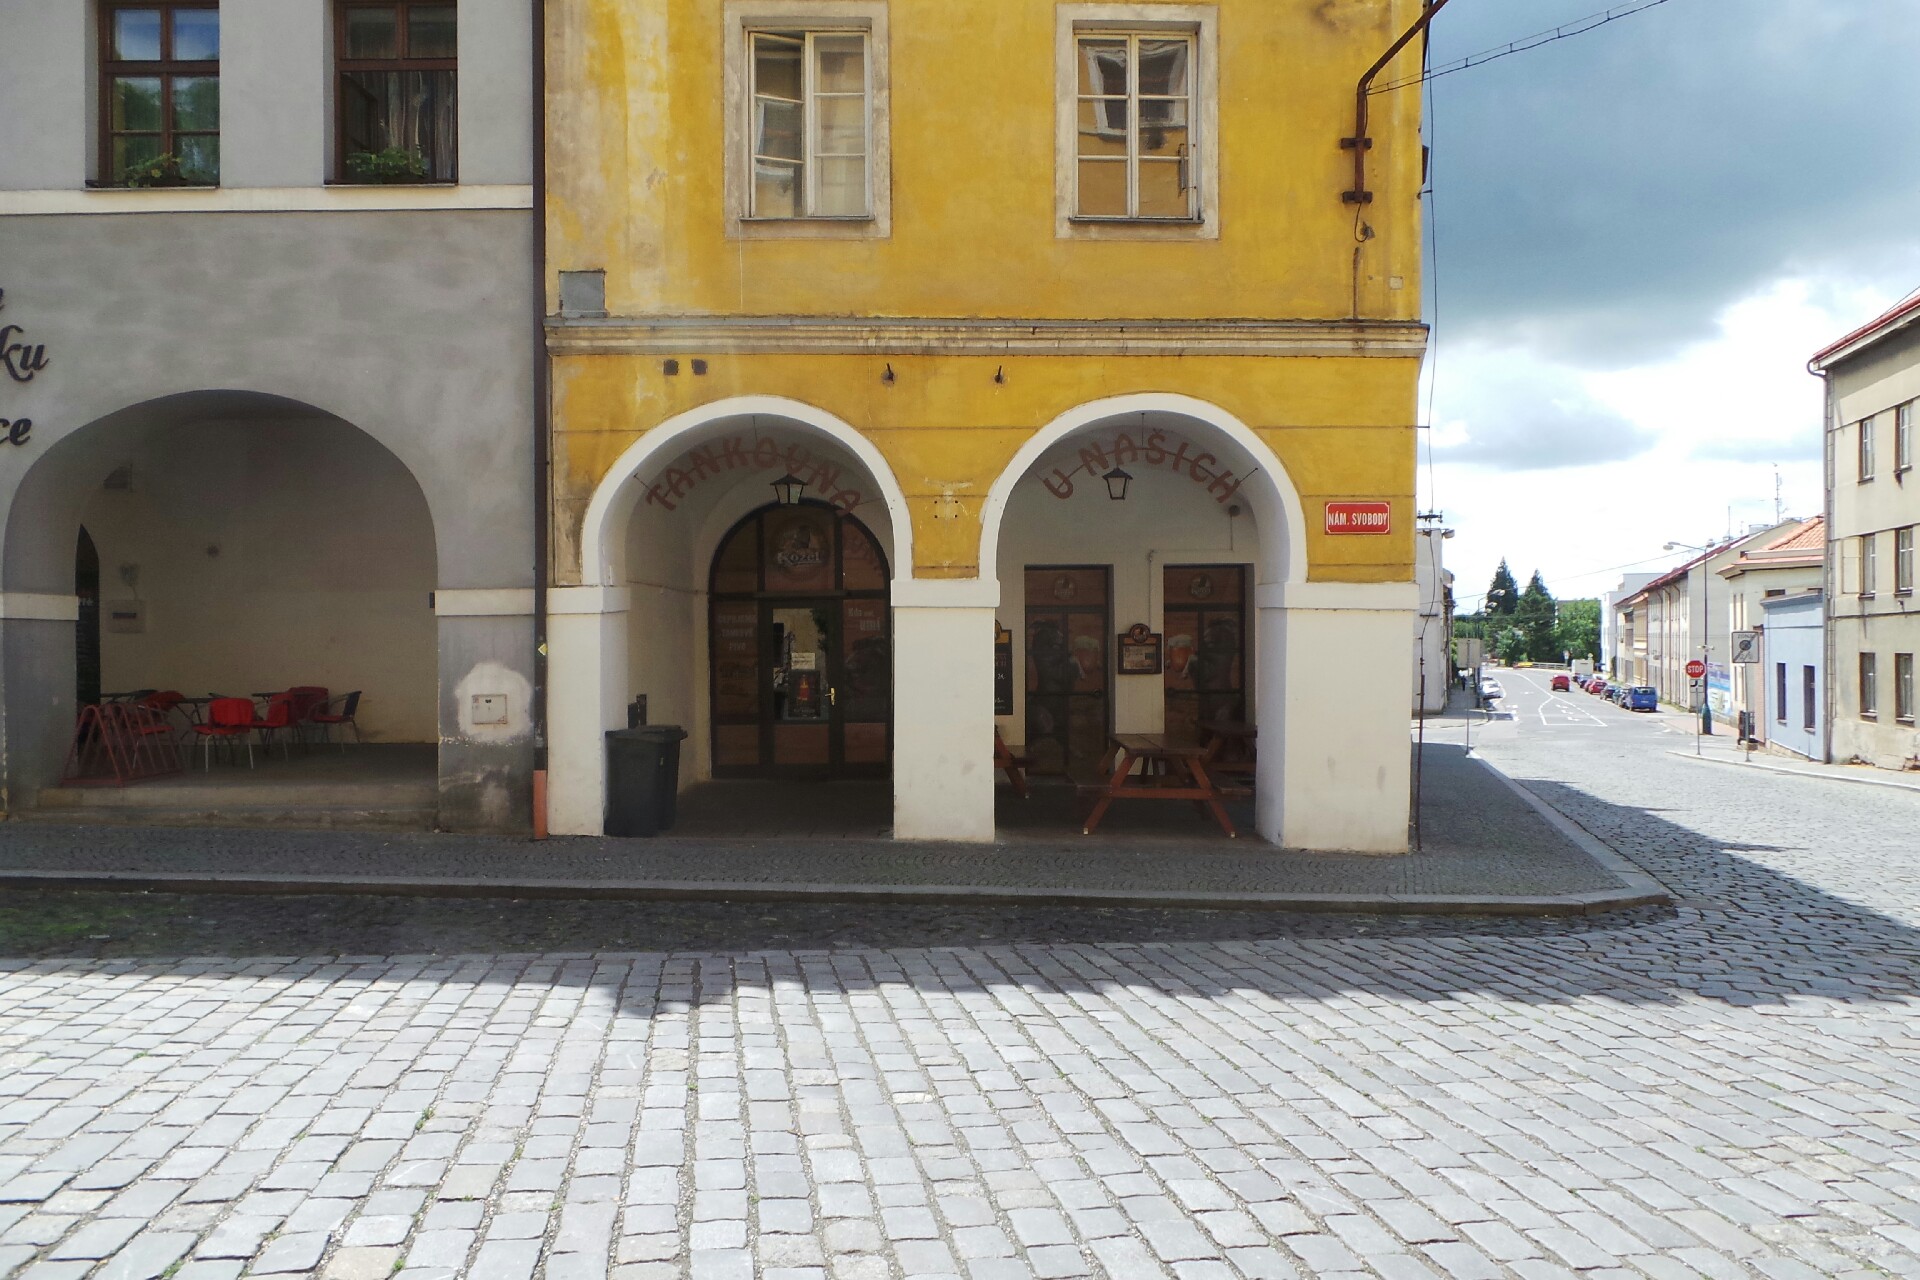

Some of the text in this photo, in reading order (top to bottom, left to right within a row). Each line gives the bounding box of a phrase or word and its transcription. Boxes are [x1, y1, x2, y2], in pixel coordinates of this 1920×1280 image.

[1043, 428, 1241, 504] U NAŠICH
[645, 436, 861, 516] TANKOVNA
[1328, 511, 1388, 526] NÁM. SVOBODY
[777, 551, 820, 567] Kozel
[1687, 665, 1704, 674] STOP
